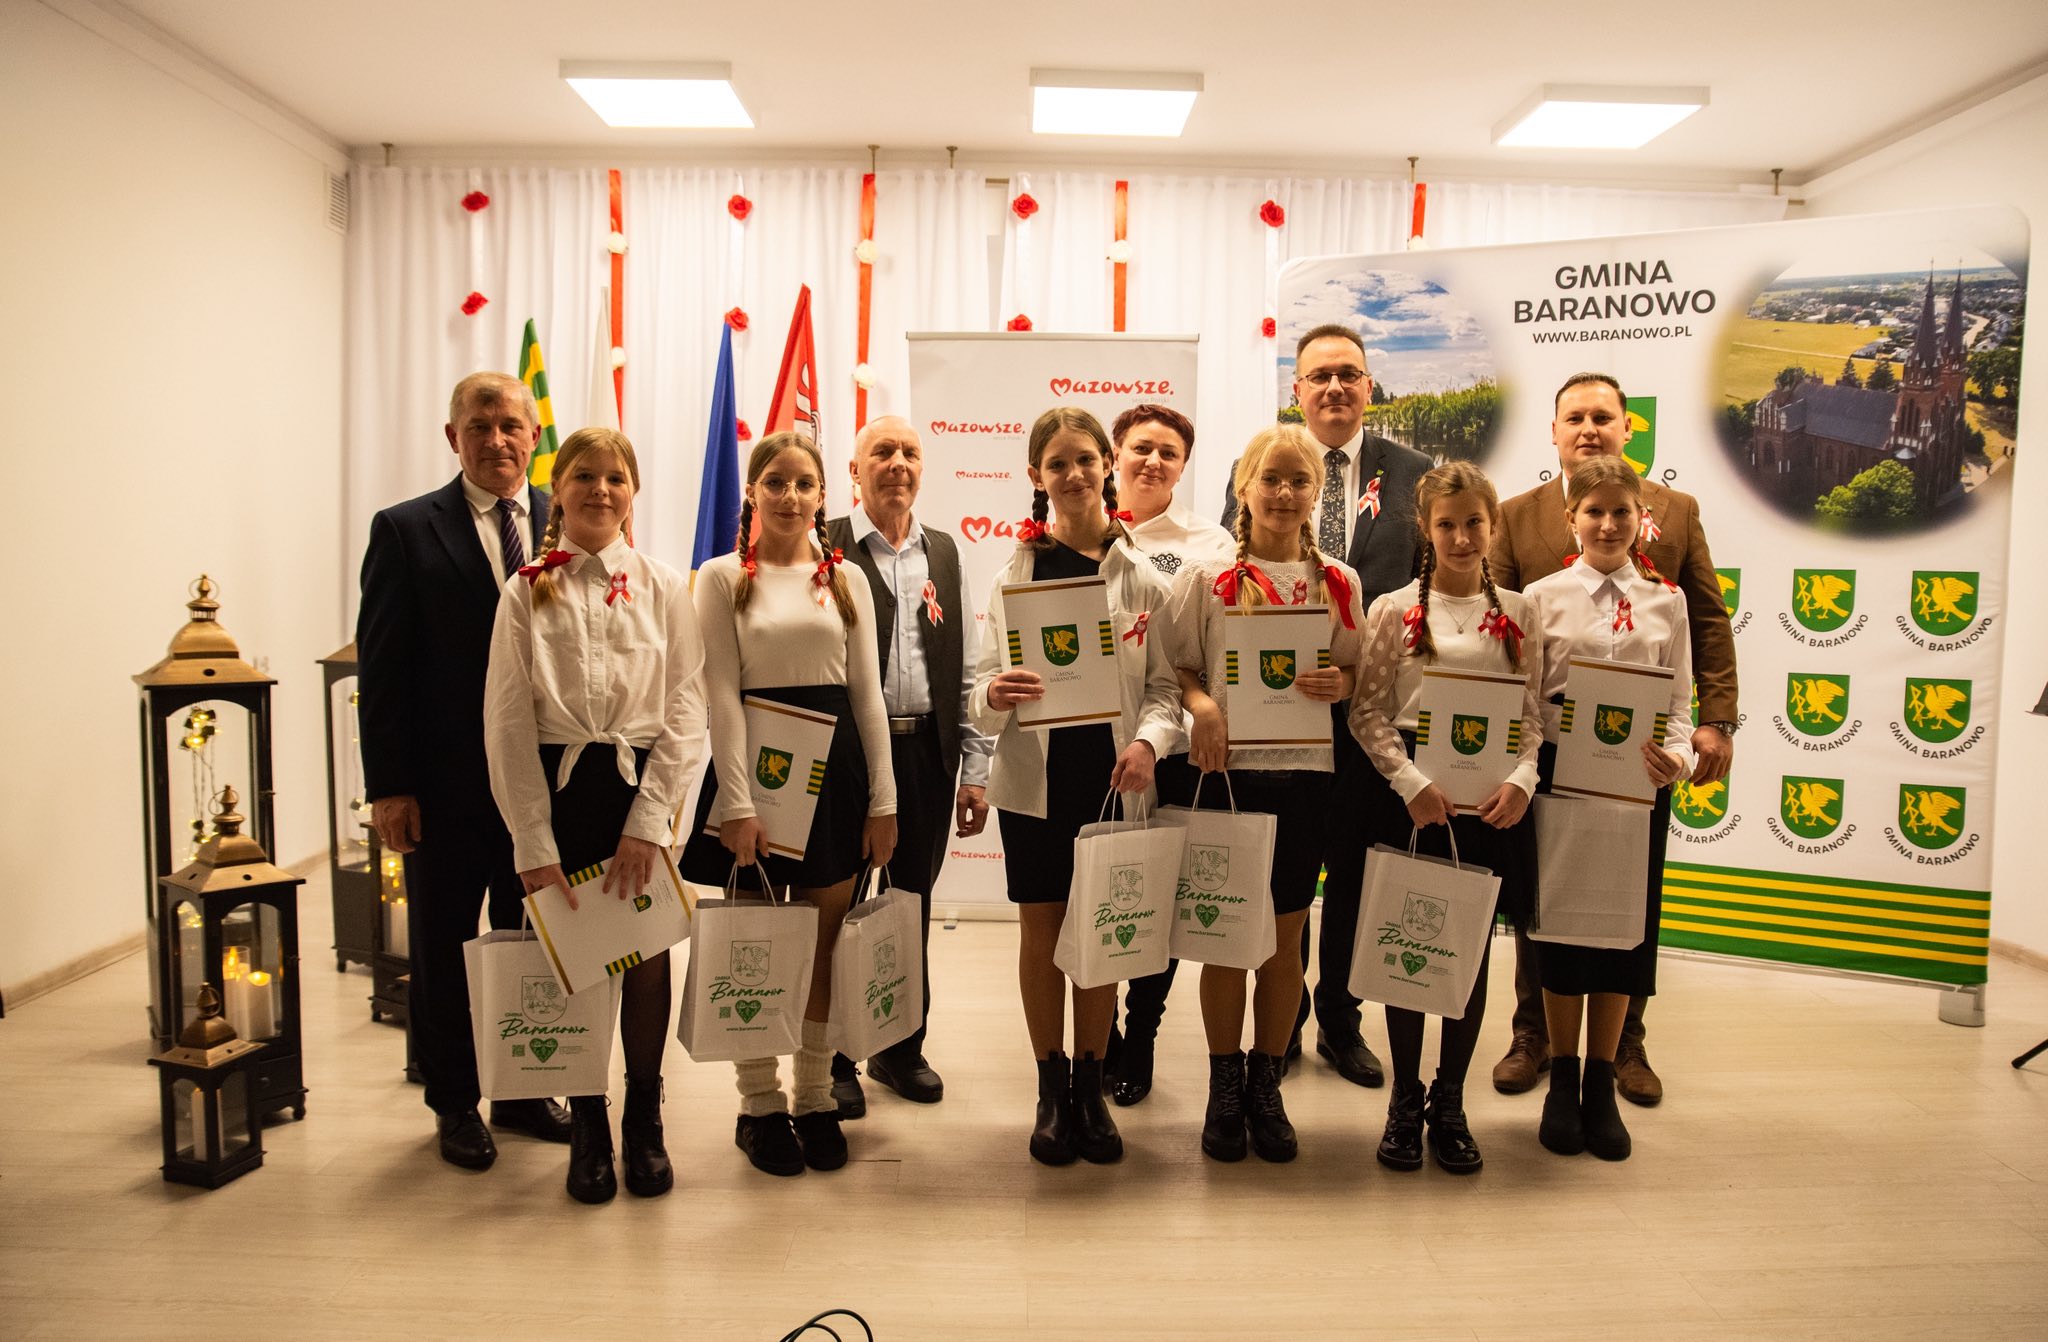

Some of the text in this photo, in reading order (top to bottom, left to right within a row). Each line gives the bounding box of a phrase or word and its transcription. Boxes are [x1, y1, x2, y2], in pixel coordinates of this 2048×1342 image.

[1555, 260, 1673, 290] GMINA
[1514, 289, 1717, 324] BARANOWO
[1532, 325, 1692, 344] WWW.BARANOWO.PL
[1049, 378, 1174, 397] Mazowsze.
[931, 421, 1026, 436] Mazowsze.
[1778, 612, 1806, 644] GMINA
[1809, 614, 1869, 648] BARANOWO
[1896, 615, 1993, 652] GMINA BARANOWO
[1772, 715, 1800, 747] GMINA
[1803, 719, 1863, 752] BARANOWO
[1889, 721, 1985, 759] GMINA BARANOWO
[1685, 814, 1742, 844] BARANOWO
[1766, 817, 1857, 855] GMINA BARANOWO
[1883, 826, 1980, 866] GMINA BARANOWO
[1175, 883, 1248, 904] Baranowo
[1093, 907, 1156, 931] Baranowo
[1377, 927, 1458, 958] Baranowo
[708, 981, 786, 1003] Baranowo
[497, 1018, 590, 1041] Baranowo
